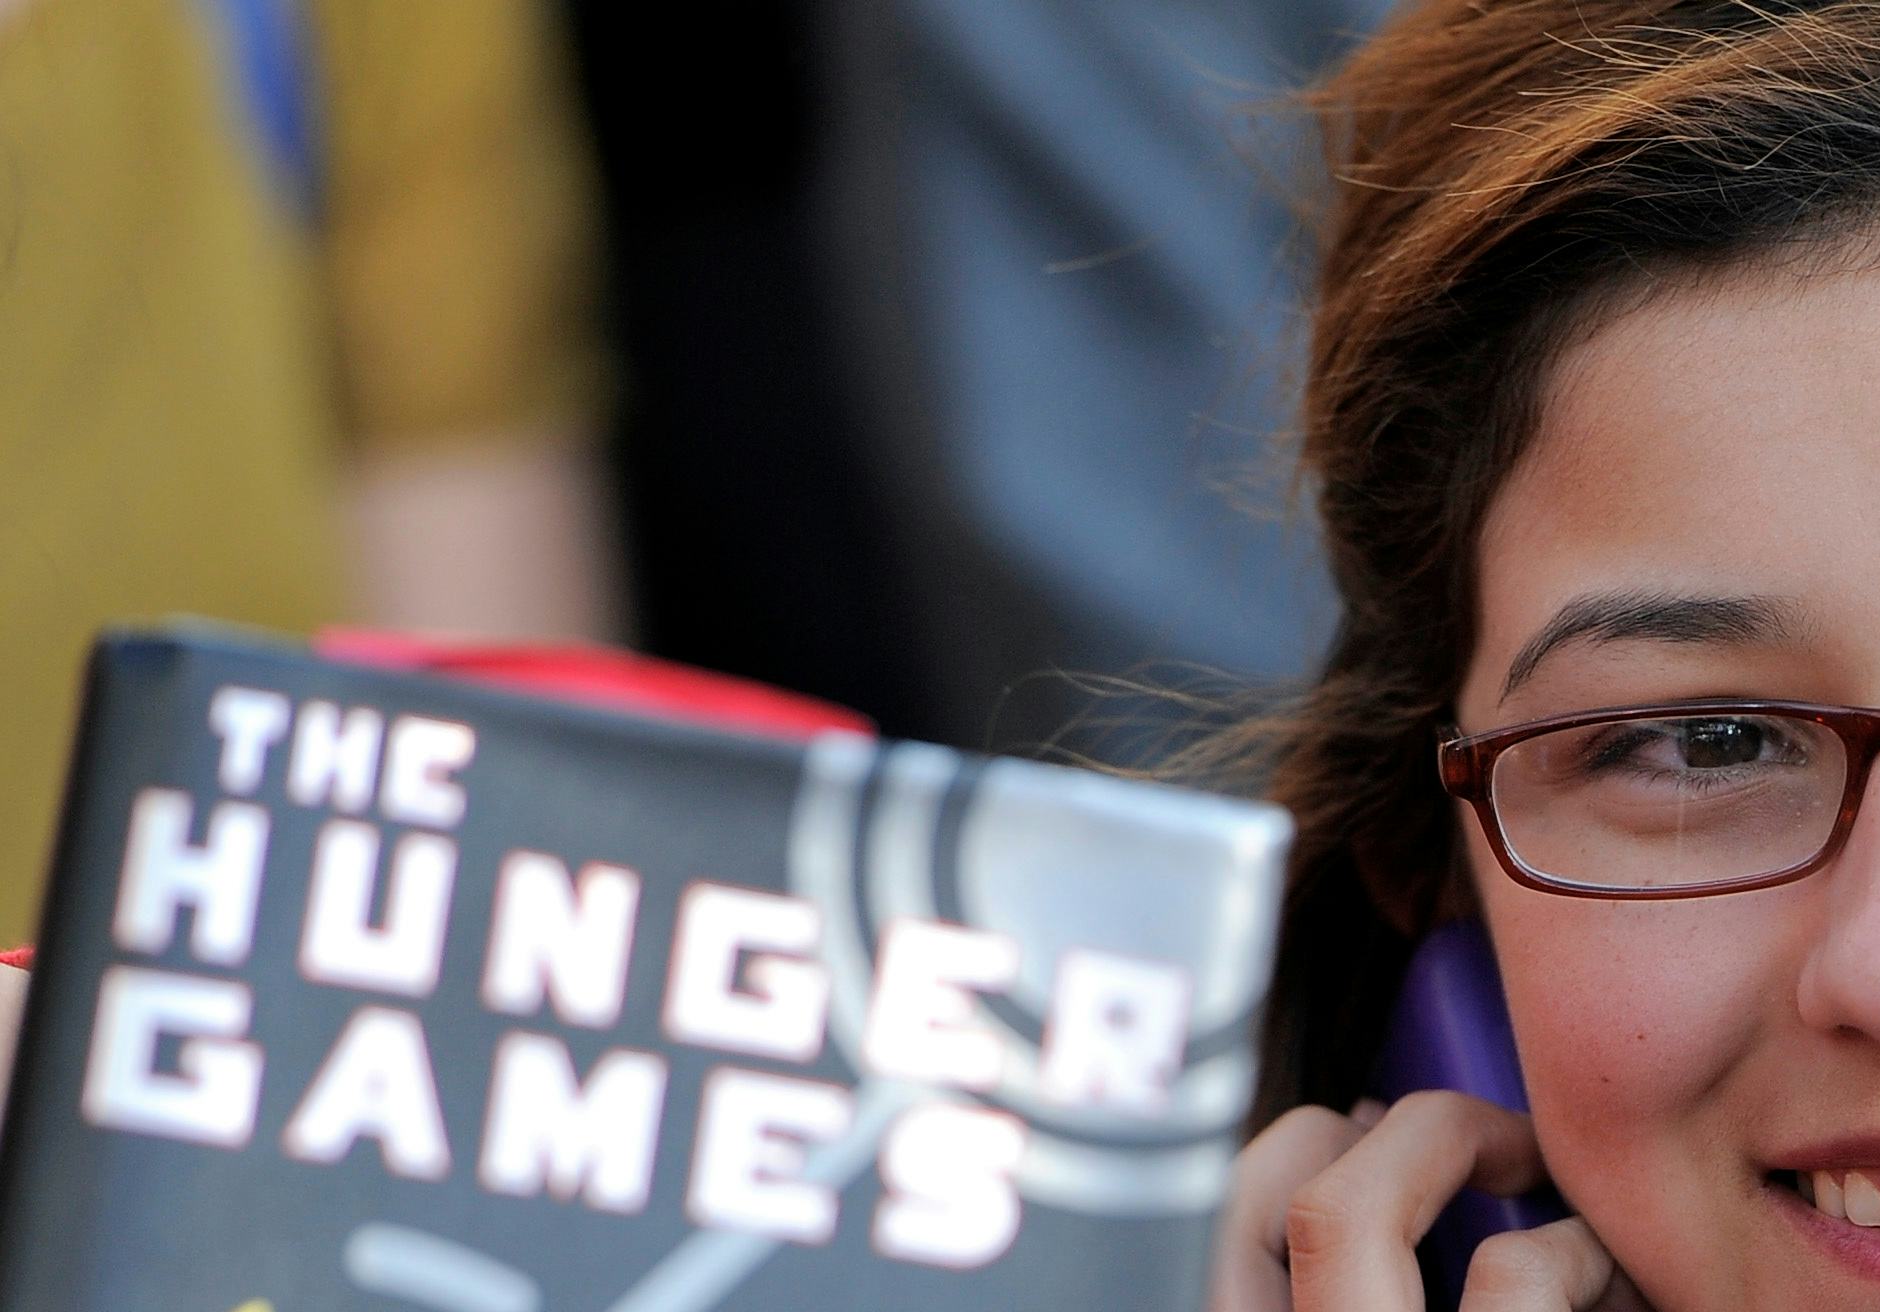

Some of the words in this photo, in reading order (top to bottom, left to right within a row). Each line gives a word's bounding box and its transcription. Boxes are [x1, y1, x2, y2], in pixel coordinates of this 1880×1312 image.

[213, 686, 476, 827] THE
[114, 789, 1190, 1114] HUNGER
[83, 965, 1027, 1268] GAMES
